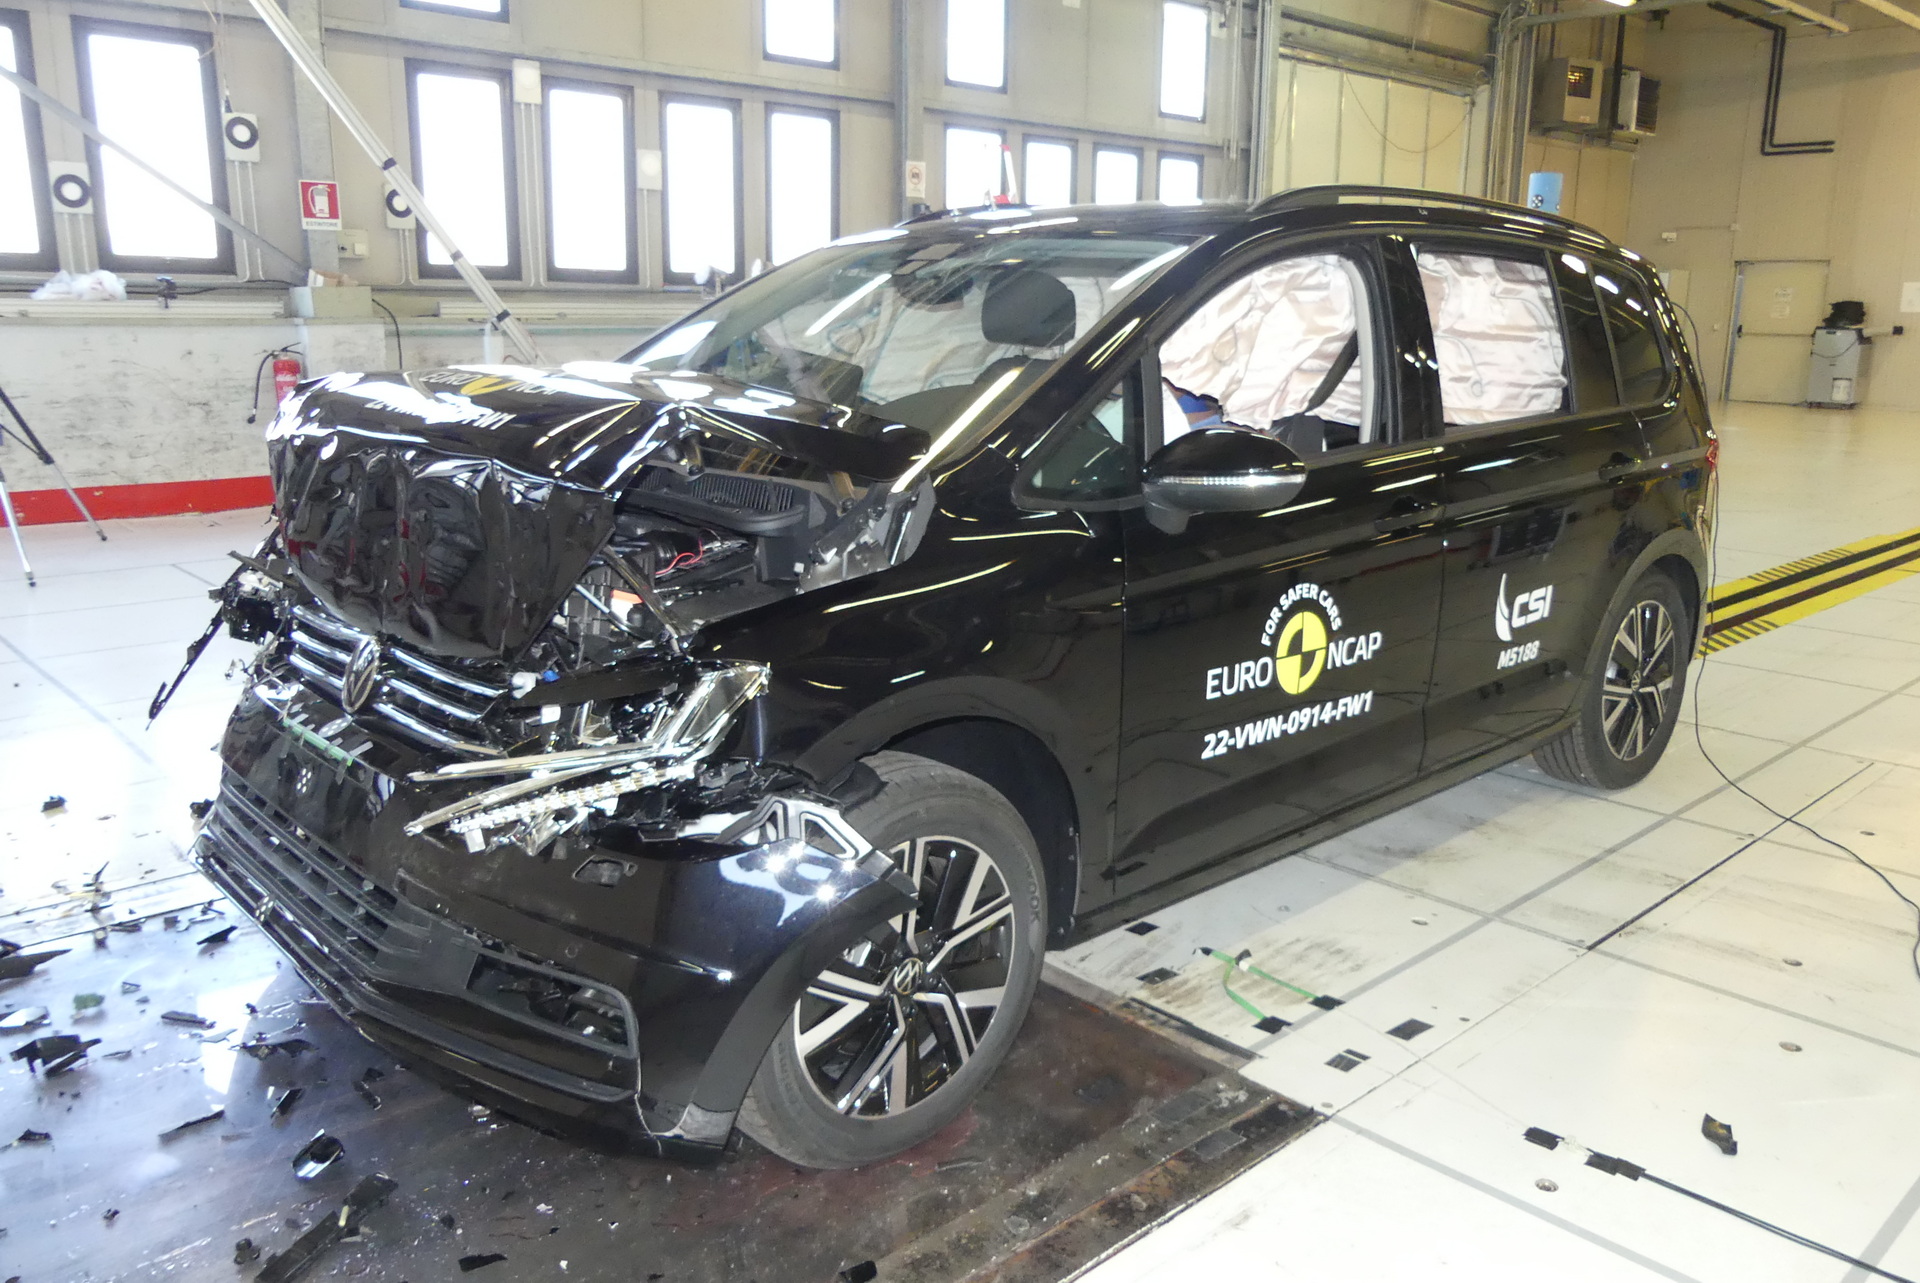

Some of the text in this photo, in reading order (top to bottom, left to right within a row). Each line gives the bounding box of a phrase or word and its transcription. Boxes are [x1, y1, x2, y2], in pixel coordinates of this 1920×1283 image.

[1261, 582, 1343, 647] FOR SAFER CARS
[1511, 584, 1553, 629] CSI
[1205, 631, 1383, 700] EURO NCAP
[1496, 640, 1540, 670] M5188
[1200, 690, 1374, 760] 22-VWN-0914-FW1
